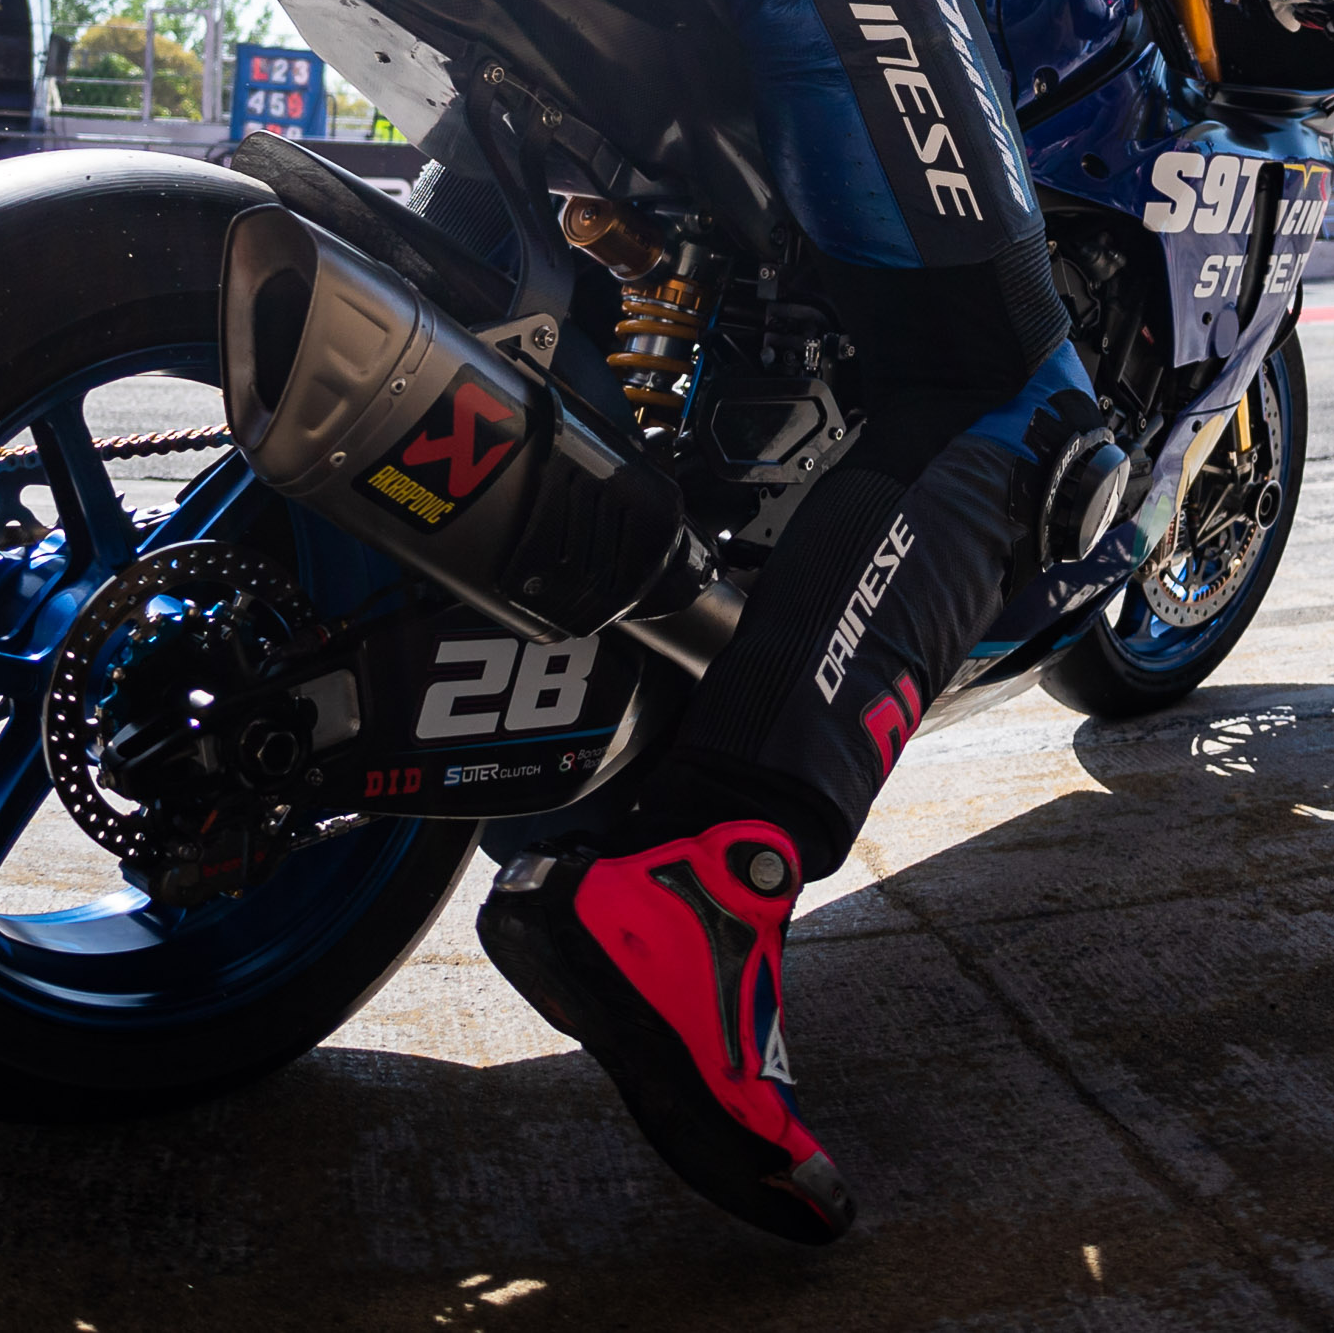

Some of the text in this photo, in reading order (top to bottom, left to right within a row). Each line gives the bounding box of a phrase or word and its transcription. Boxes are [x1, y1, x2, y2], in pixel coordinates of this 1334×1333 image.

[367, 465, 455, 524] AKRAPOVIČ
[814, 513, 915, 705] DAINESE
[416, 633, 600, 740] 28
[444, 763, 541, 785] SUTER CLUTCH
